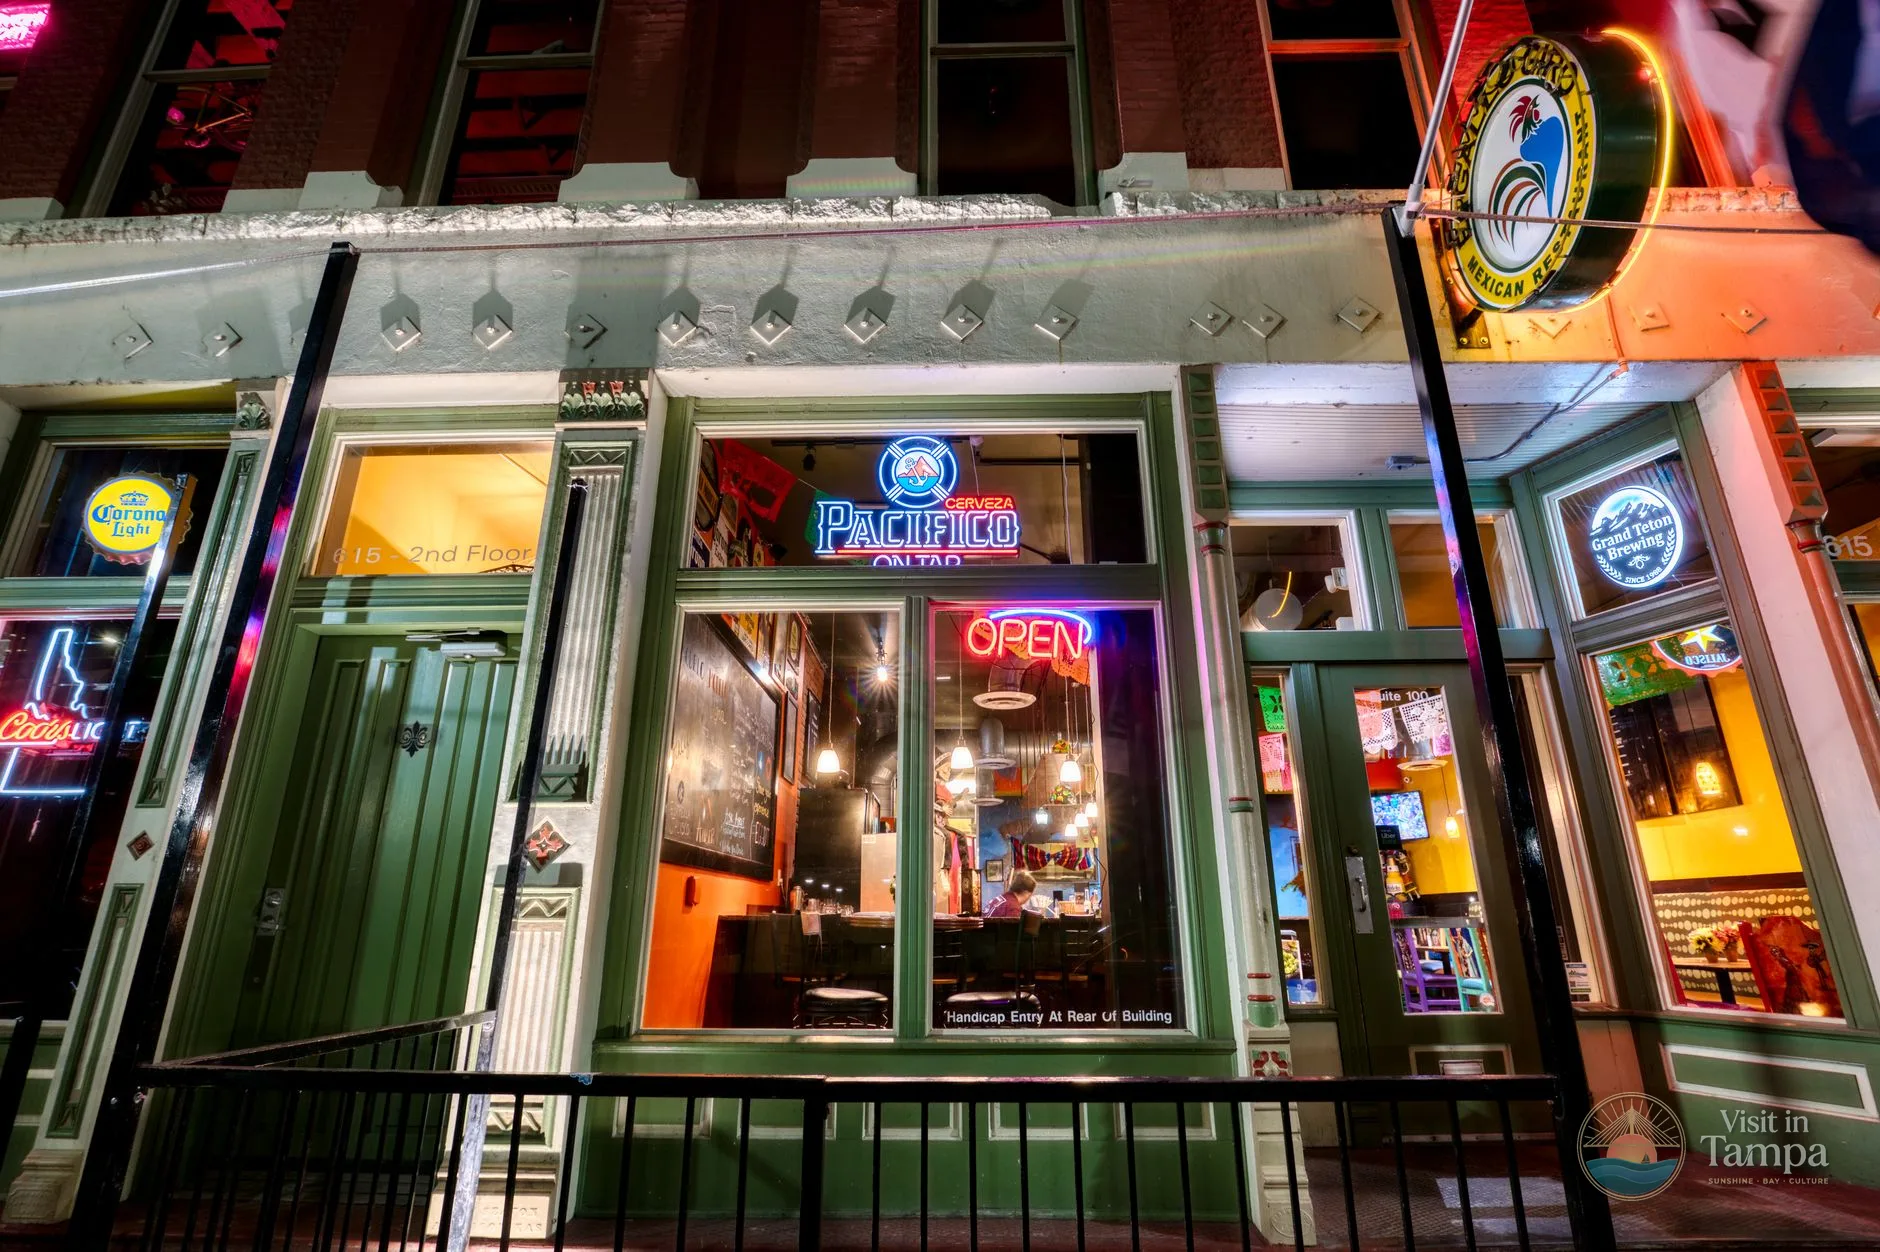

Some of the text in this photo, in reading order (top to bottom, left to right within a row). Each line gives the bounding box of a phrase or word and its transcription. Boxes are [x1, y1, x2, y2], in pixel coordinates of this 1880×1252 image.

[1467, 255, 1525, 298] MEXICAN
[945, 497, 1014, 510] CERVEZA
[92, 504, 167, 525] Corona
[112, 521, 150, 537] Light
[814, 501, 1020, 553] PACIFICO
[1592, 515, 1673, 551] Grand Teton
[332, 547, 382, 564] 615
[408, 546, 457, 563] 2nd
[466, 544, 532, 562] Floor
[1607, 532, 1665, 561] Brewing
[1822, 535, 1873, 557] 615
[1624, 566, 1663, 584] SINCE 1988
[967, 617, 1084, 659] OPEN
[1373, 690, 1429, 702] uite 100
[0, 712, 73, 740] Coors
[947, 1011, 1006, 1025] Handicap
[1011, 1010, 1043, 1024] Entry
[1049, 1010, 1063, 1023] At
[1068, 1010, 1097, 1022] Rear
[1122, 1010, 1172, 1023] Building
